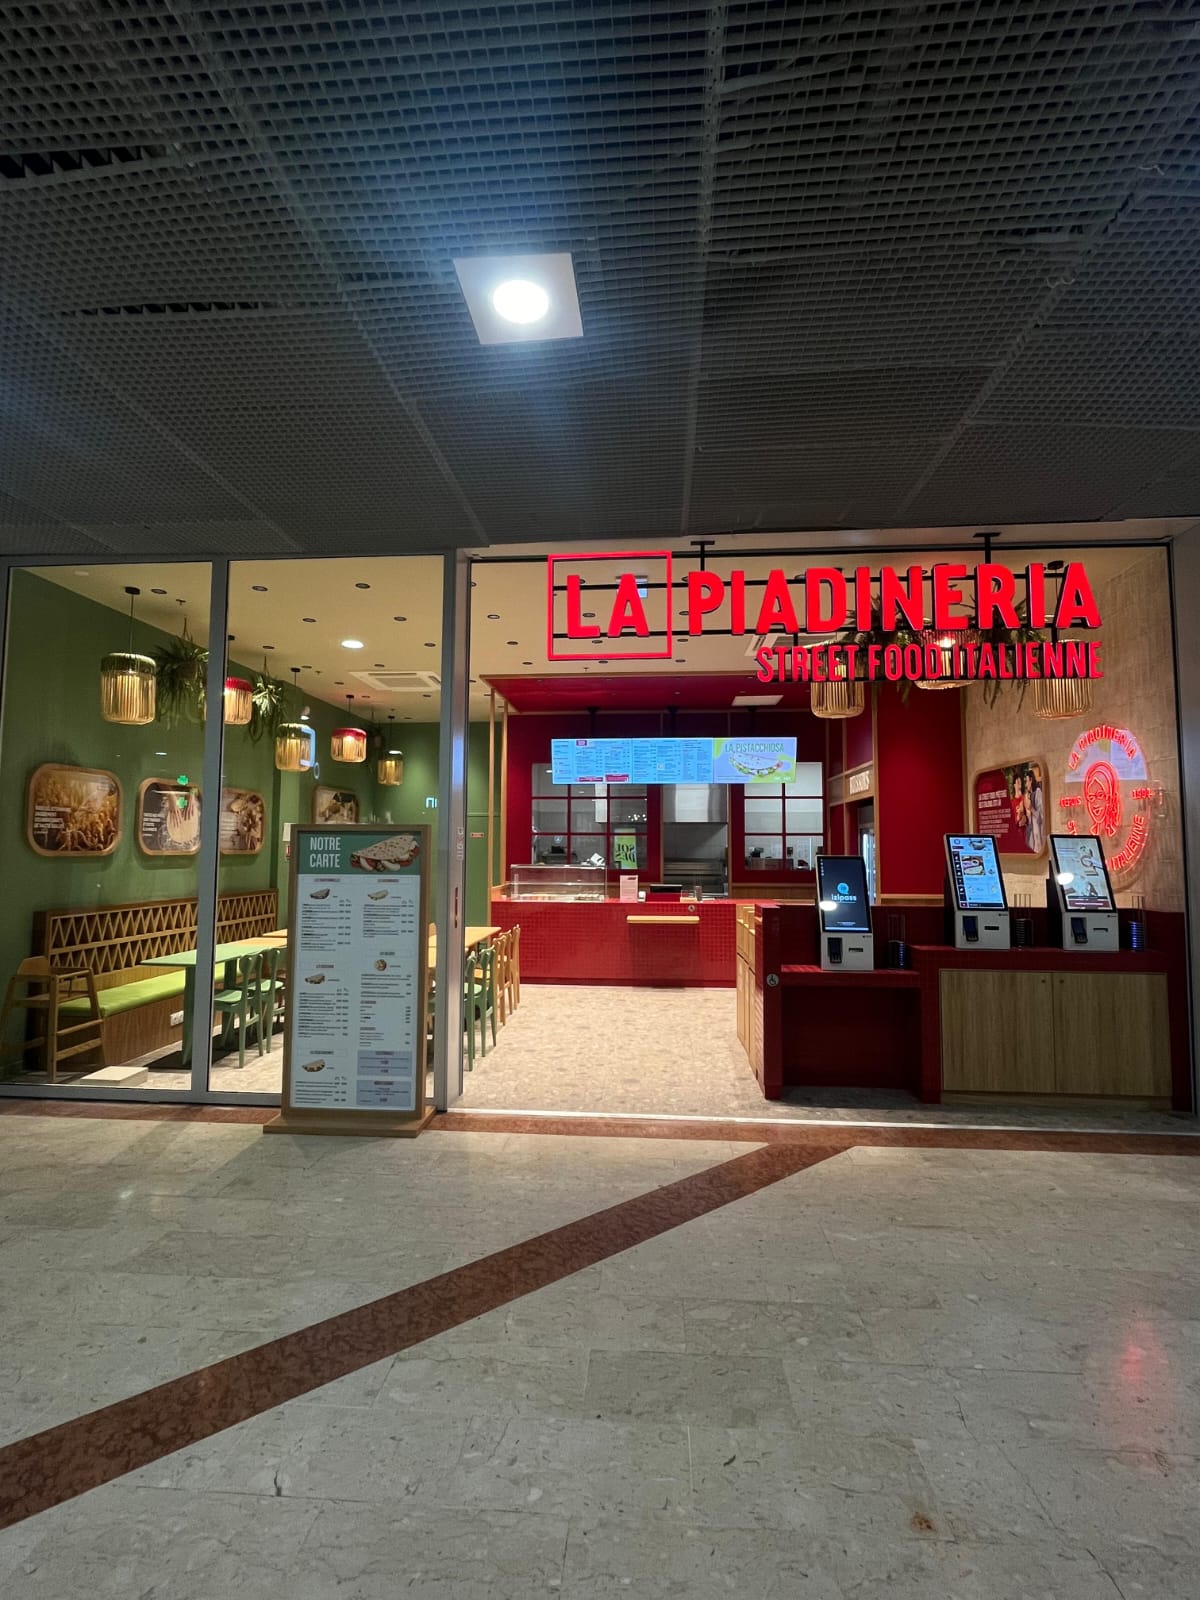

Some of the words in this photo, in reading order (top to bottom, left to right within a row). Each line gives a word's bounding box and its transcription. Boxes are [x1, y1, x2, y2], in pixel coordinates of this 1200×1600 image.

[566, 573, 649, 639] LA
[688, 562, 1102, 636] PIADINERIA
[755, 643, 860, 683] STREET
[868, 643, 942, 682] FOOD
[953, 641, 1104, 680] ITALIENNE
[725, 743, 734, 753] LA
[736, 743, 785, 753] PISTACCHIOSA
[309, 837, 342, 851] NOTRE
[309, 853, 341, 868] CARTE
